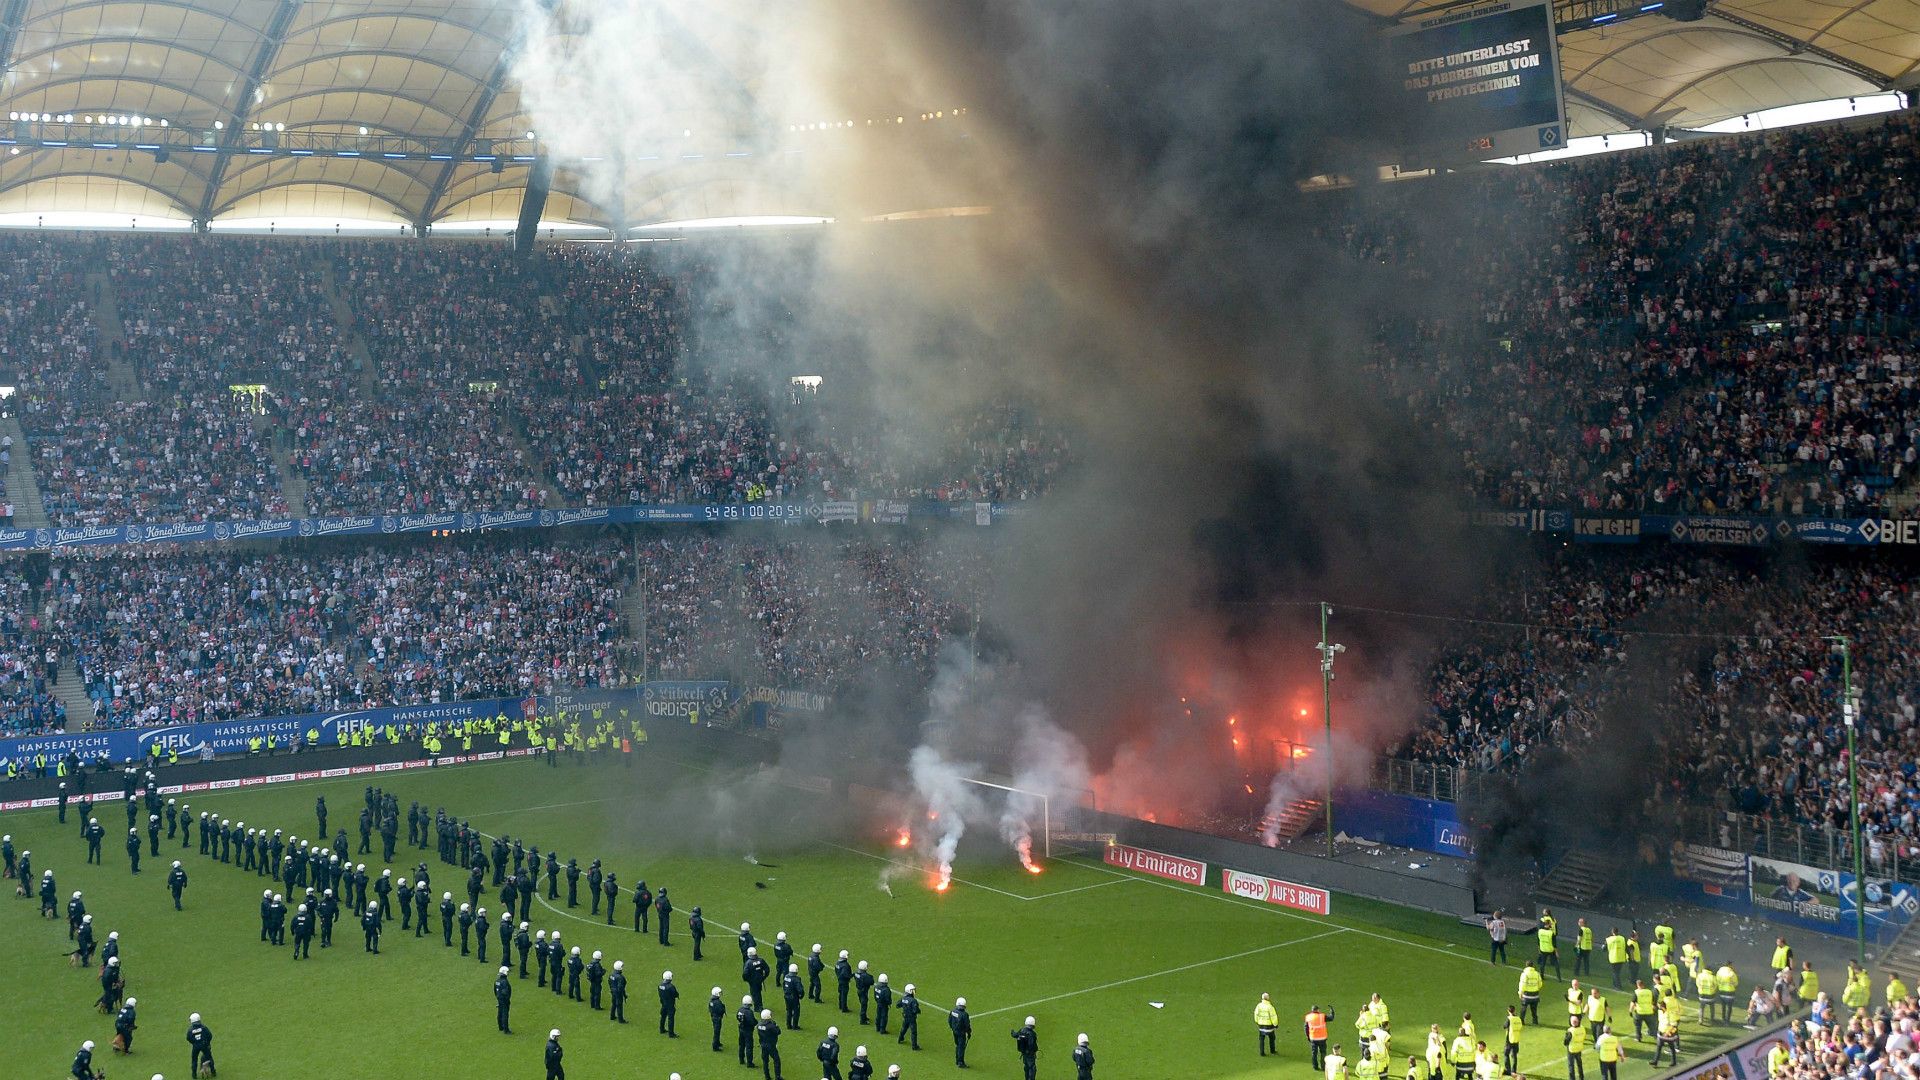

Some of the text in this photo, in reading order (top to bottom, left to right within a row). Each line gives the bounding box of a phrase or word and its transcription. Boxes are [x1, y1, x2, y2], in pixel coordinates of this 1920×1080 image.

[1408, 39, 1531, 74] BITTE UNTERLASST
[1404, 54, 1540, 90] DAS ABBRENNEN VON
[1427, 75, 1521, 102] PYROTECHNIK!
[705, 507, 718, 518] 54
[749, 506, 763, 516] 00
[769, 506, 782, 516] 20
[787, 505, 801, 516] 54
[0, 530, 26, 539] lsener
[1881, 520, 1920, 543] BIE
[555, 695, 572, 704] Der
[393, 706, 472, 720] HANSEATISCHE
[215, 721, 299, 736] HANSEATISCHE
[18, 737, 109, 752] HANSEATISCHE
[154, 733, 191, 748] HEK
[242, 777, 264, 785] tipico
[1110, 847, 1198, 880] Fly Emirates
[1235, 880, 1264, 896] popp
[1272, 885, 1321, 909] AUF'S BROT
[1755, 893, 1837, 920] Hermann FOREVER
